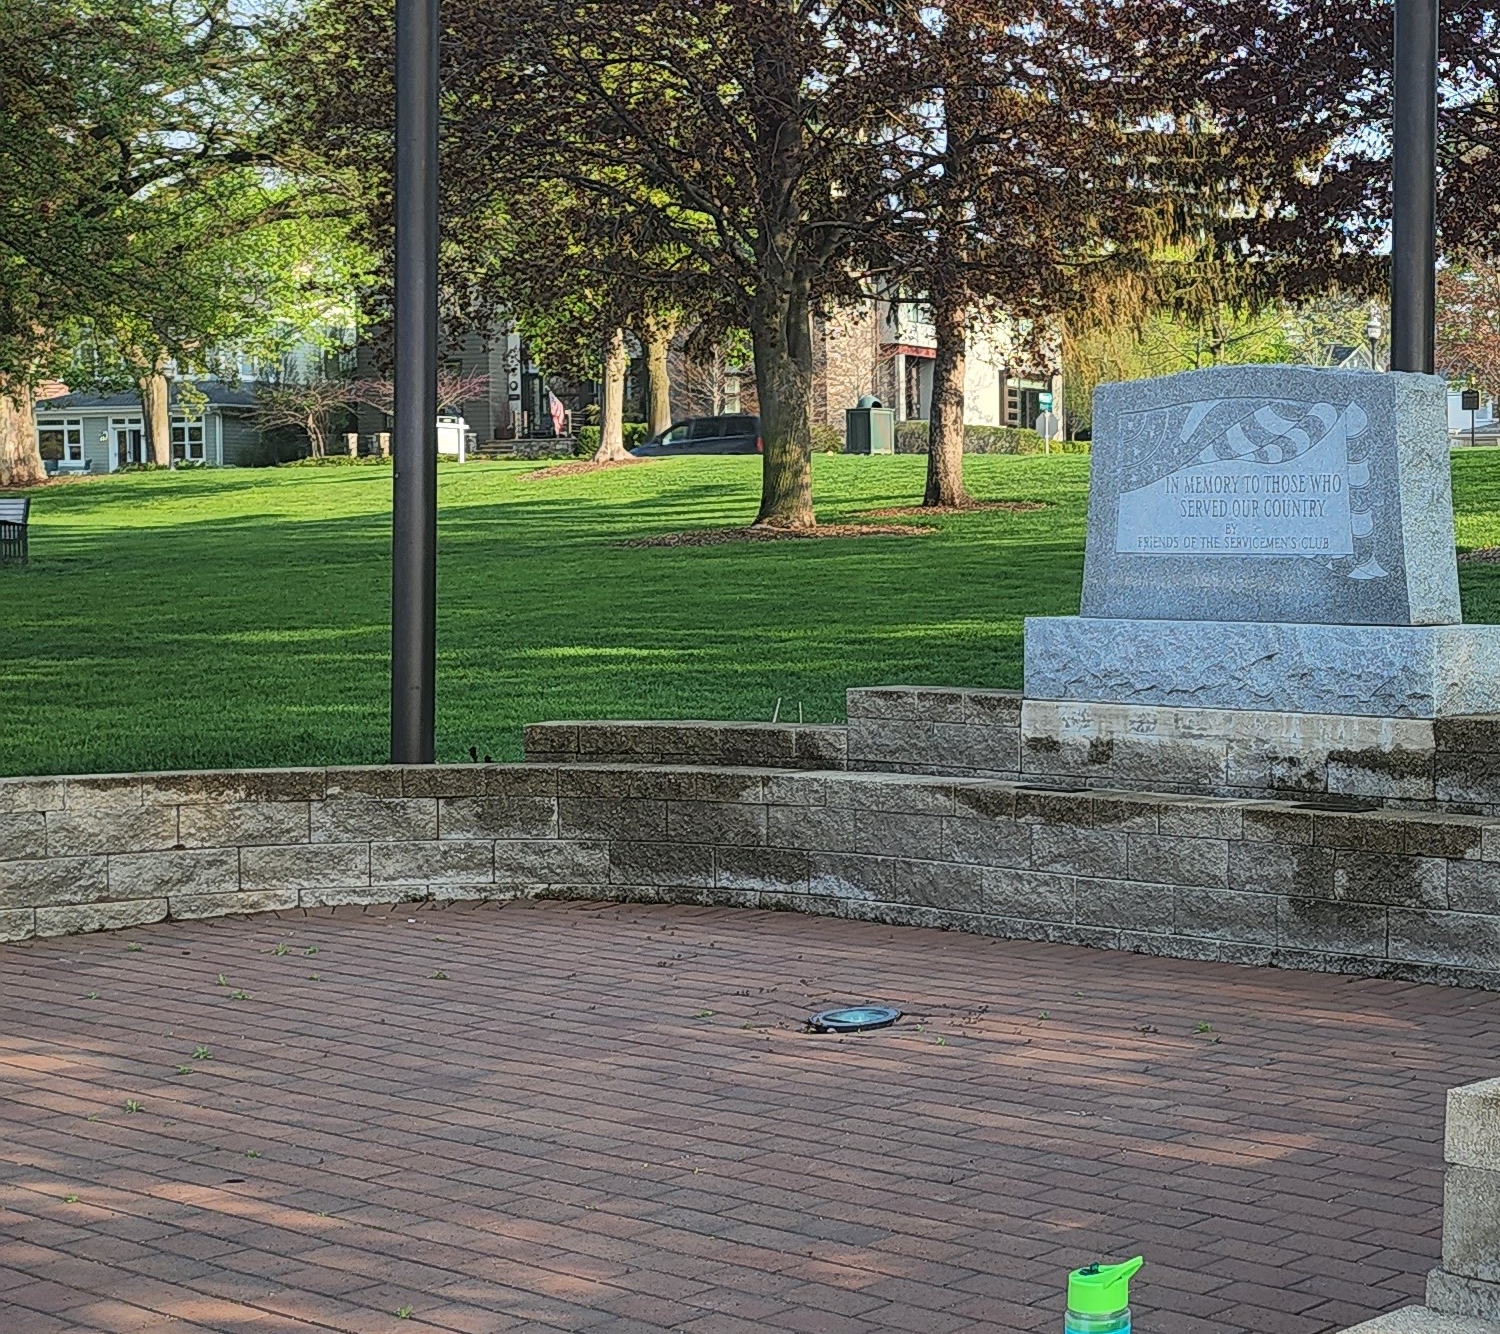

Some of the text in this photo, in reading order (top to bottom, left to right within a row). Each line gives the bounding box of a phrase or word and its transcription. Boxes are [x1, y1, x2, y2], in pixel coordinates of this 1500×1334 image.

[1165, 474, 1342, 494] IN MEMORY TO THOSE WHO
[1180, 499, 1326, 518] SERVED OUR COUNTRY
[1225, 523, 1239, 535] BY
[1137, 536, 1180, 548] FRIENDS
[1183, 536, 1197, 548] OF
[1200, 536, 1221, 548] THE
[1301, 537, 1329, 549] CLUB
